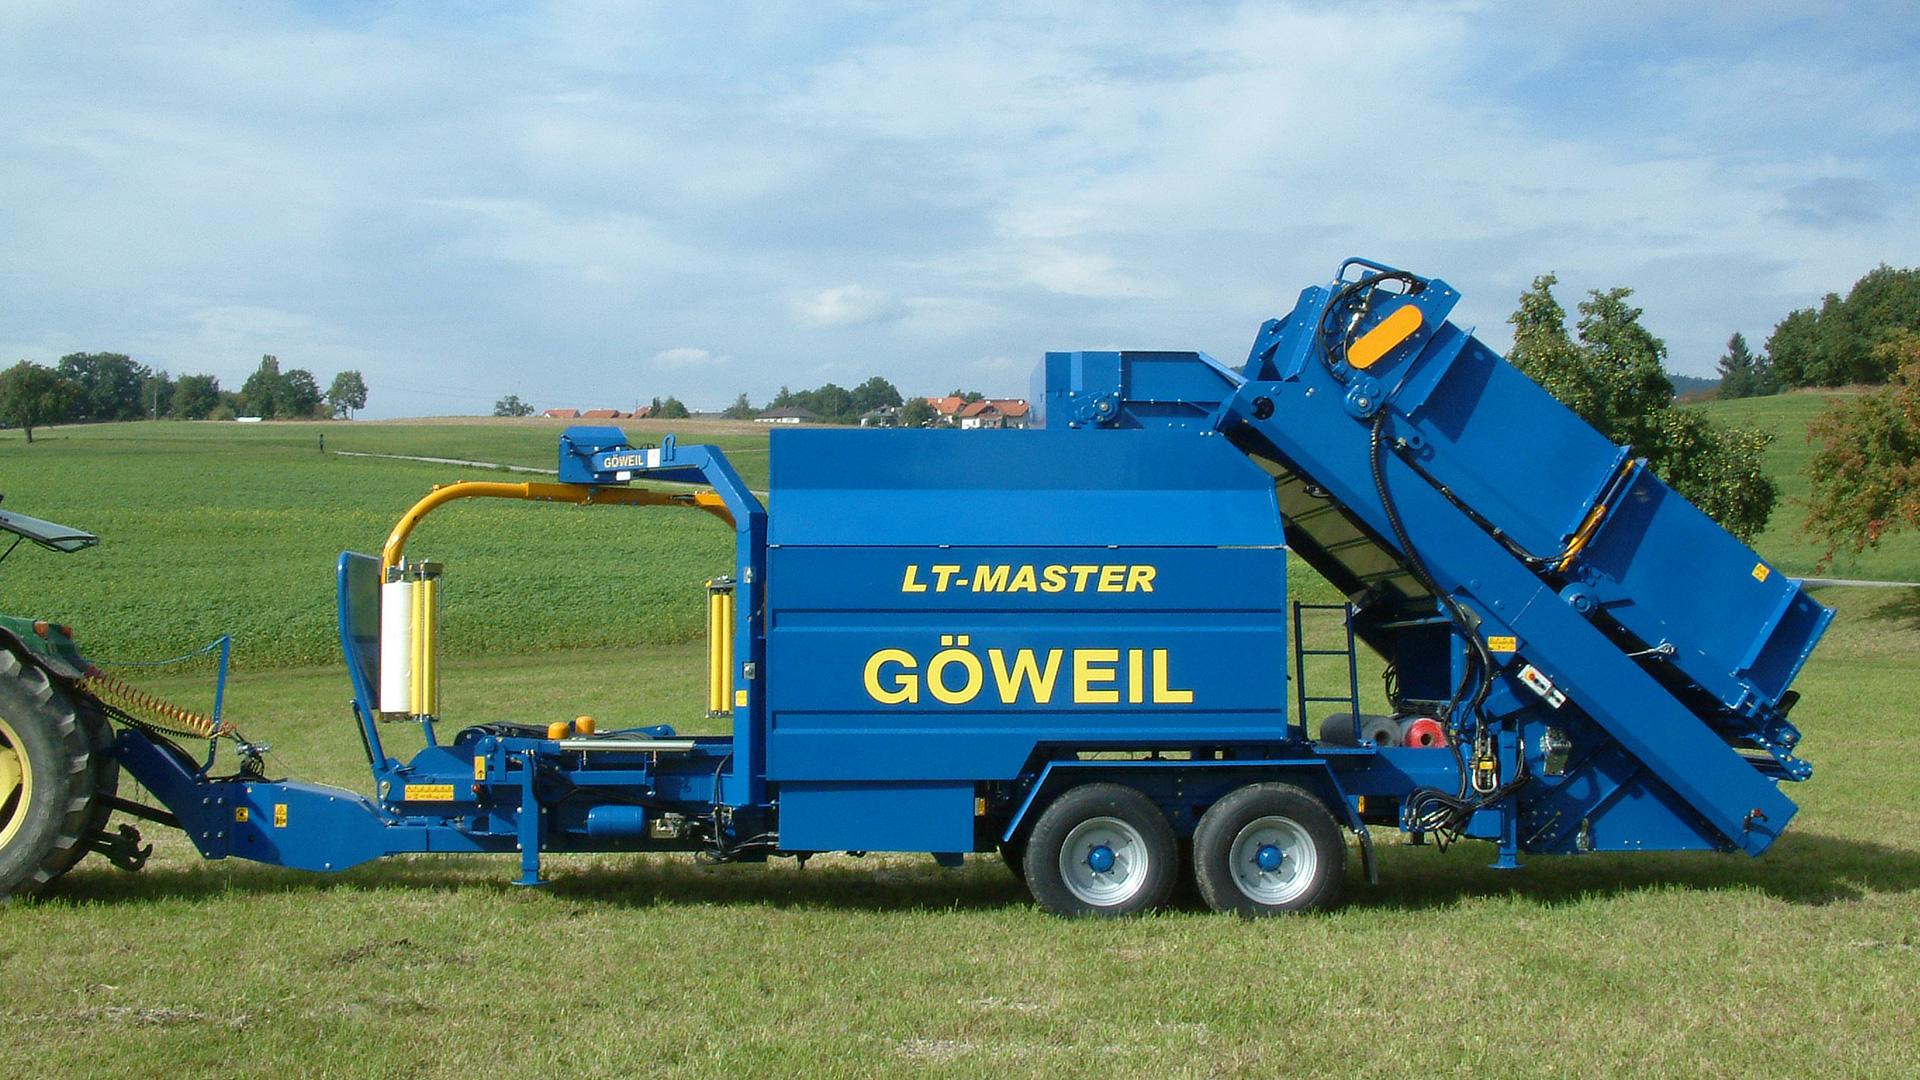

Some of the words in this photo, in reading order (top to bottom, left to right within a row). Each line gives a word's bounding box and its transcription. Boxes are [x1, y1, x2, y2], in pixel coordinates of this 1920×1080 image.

[604, 454, 644, 468] GÖWEIL
[902, 565, 1156, 592] LT-MASTER
[863, 635, 1194, 704] GÖWEIL
